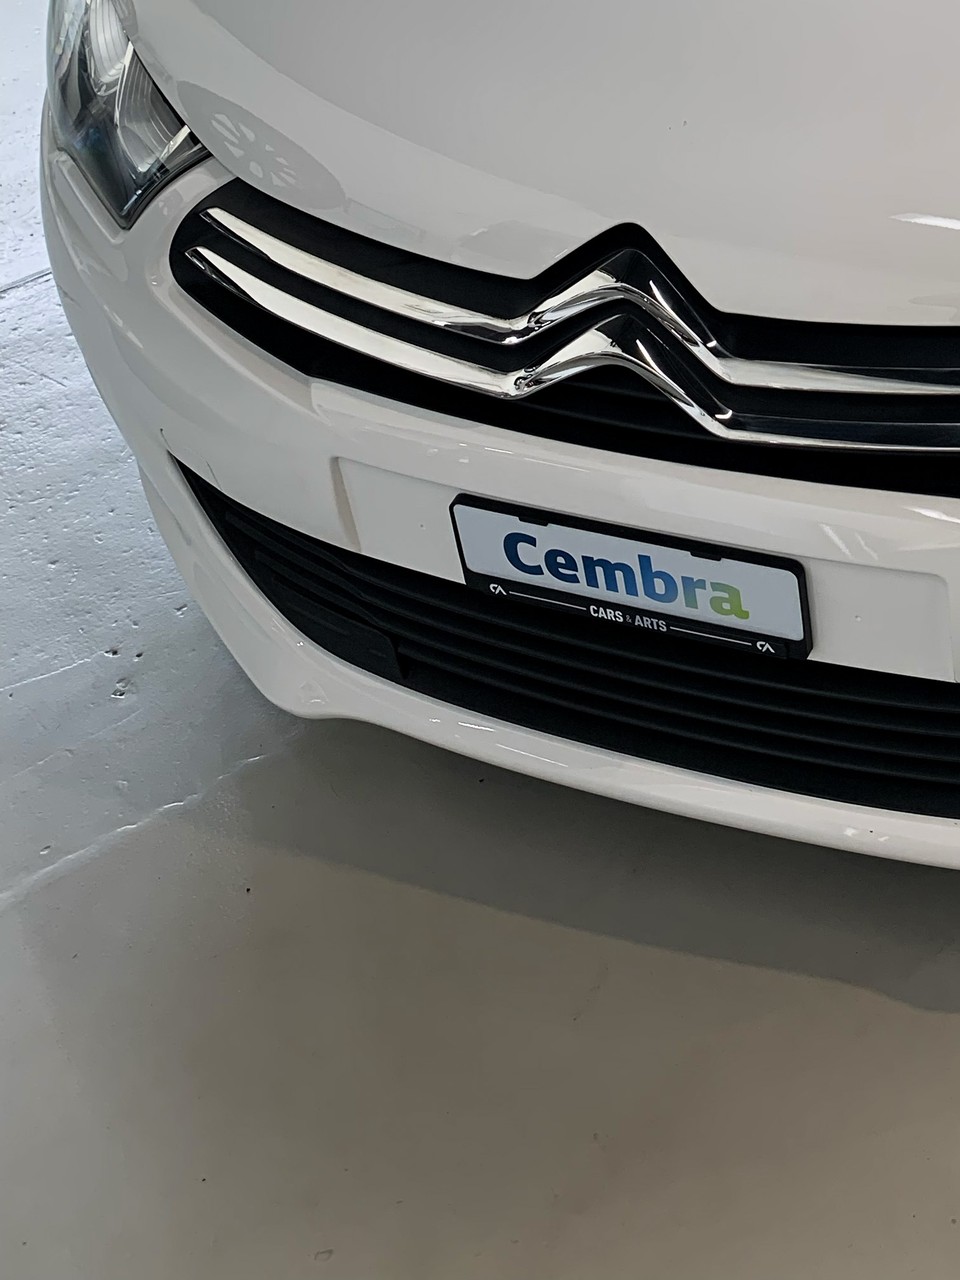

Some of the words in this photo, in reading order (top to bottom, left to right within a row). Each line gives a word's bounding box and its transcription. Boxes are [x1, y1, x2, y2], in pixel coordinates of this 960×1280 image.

[503, 532, 750, 620] Cembra
[589, 605, 624, 623] CARS
[634, 615, 667, 632] ARTS
